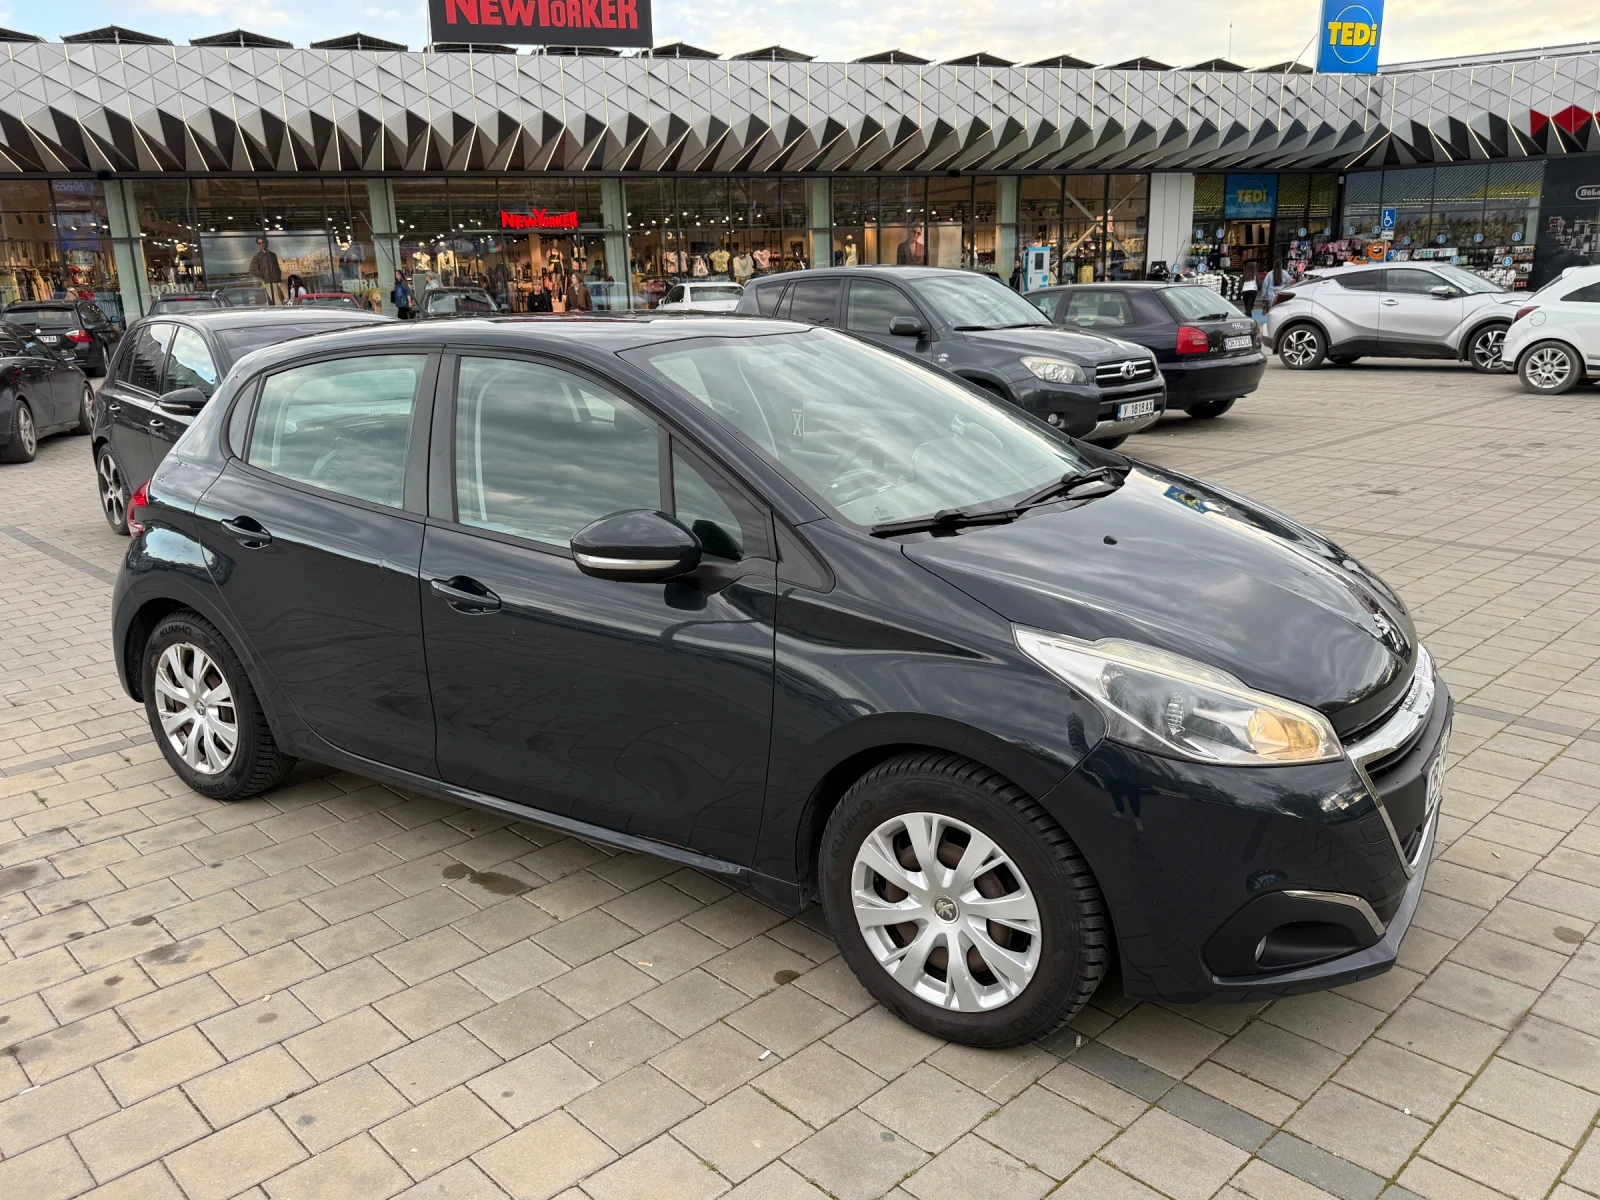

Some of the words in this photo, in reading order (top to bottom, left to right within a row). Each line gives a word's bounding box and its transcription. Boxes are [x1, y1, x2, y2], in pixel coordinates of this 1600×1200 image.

[1328, 22, 1377, 47] TEDi
[1237, 189, 1267, 203] TEDi
[160, 625, 192, 638] KUMHO
[830, 799, 874, 861] KUMHO
